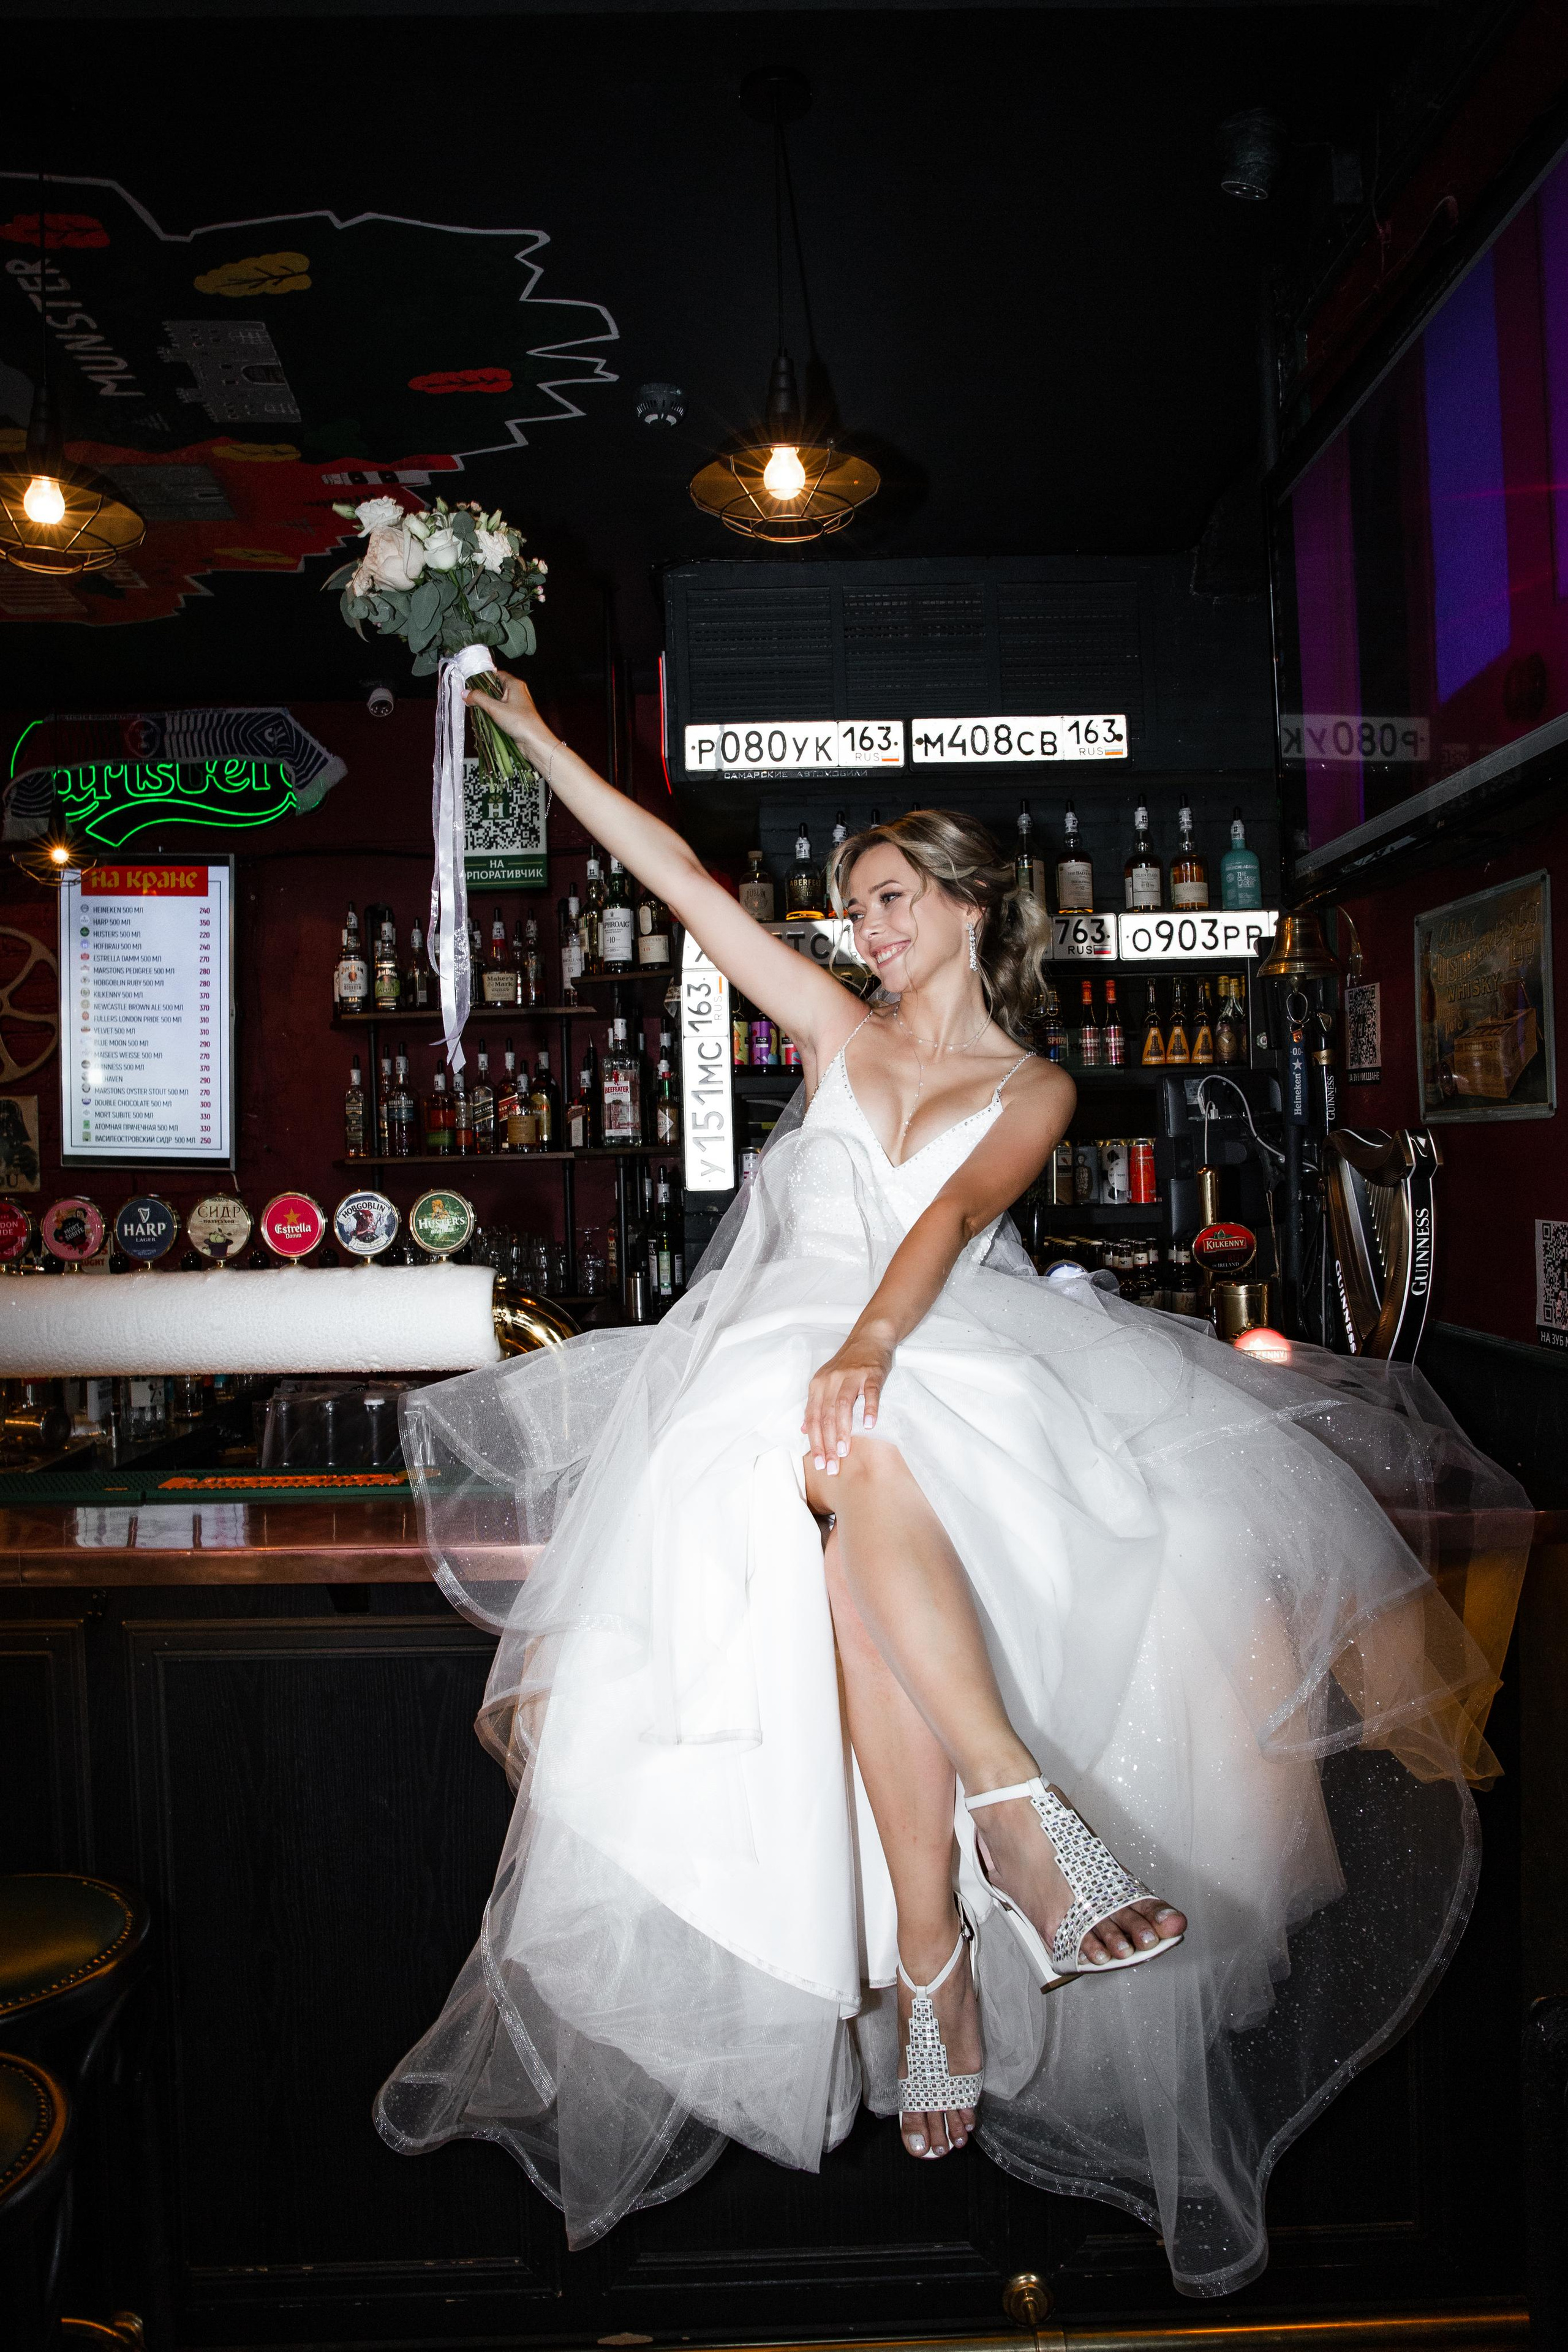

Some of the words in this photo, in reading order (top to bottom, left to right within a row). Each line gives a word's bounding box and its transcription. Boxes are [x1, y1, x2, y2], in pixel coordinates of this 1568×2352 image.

[5, 258, 146, 396] MUNSTER
[843, 728, 891, 751] 163
[1068, 721, 1115, 744] 163
[856, 753, 879, 761] RUS
[1079, 747, 1102, 756] RUS
[464, 869, 543, 880] РПОРАТИВЧИК
[1055, 919, 1105, 944] 763
[1068, 946, 1092, 954] RUS
[687, 983, 712, 1033] 163
[604, 1085, 630, 1094] BEEFEATER
[1294, 1073, 1302, 1115] Heineken
[1327, 1075, 1336, 1120] GUINNESS
[198, 1205, 241, 1219] СИДР
[342, 1202, 386, 1219] HOBGOBLIN
[64, 1223, 80, 1235] MORT
[274, 1223, 312, 1234] Estrella
[418, 1216, 466, 1229] HUSTER'S
[65, 1227, 85, 1241] SUBITE
[124, 1223, 167, 1237] HARP
[1206, 1239, 1245, 1250] KILKENNY
[1411, 1207, 1430, 1296] GUINNESS
[1335, 1259, 1357, 1354] GUINNESS
[1540, 1331, 1551, 1343] НА
[1551, 1334, 1564, 1346] ЗУБ
